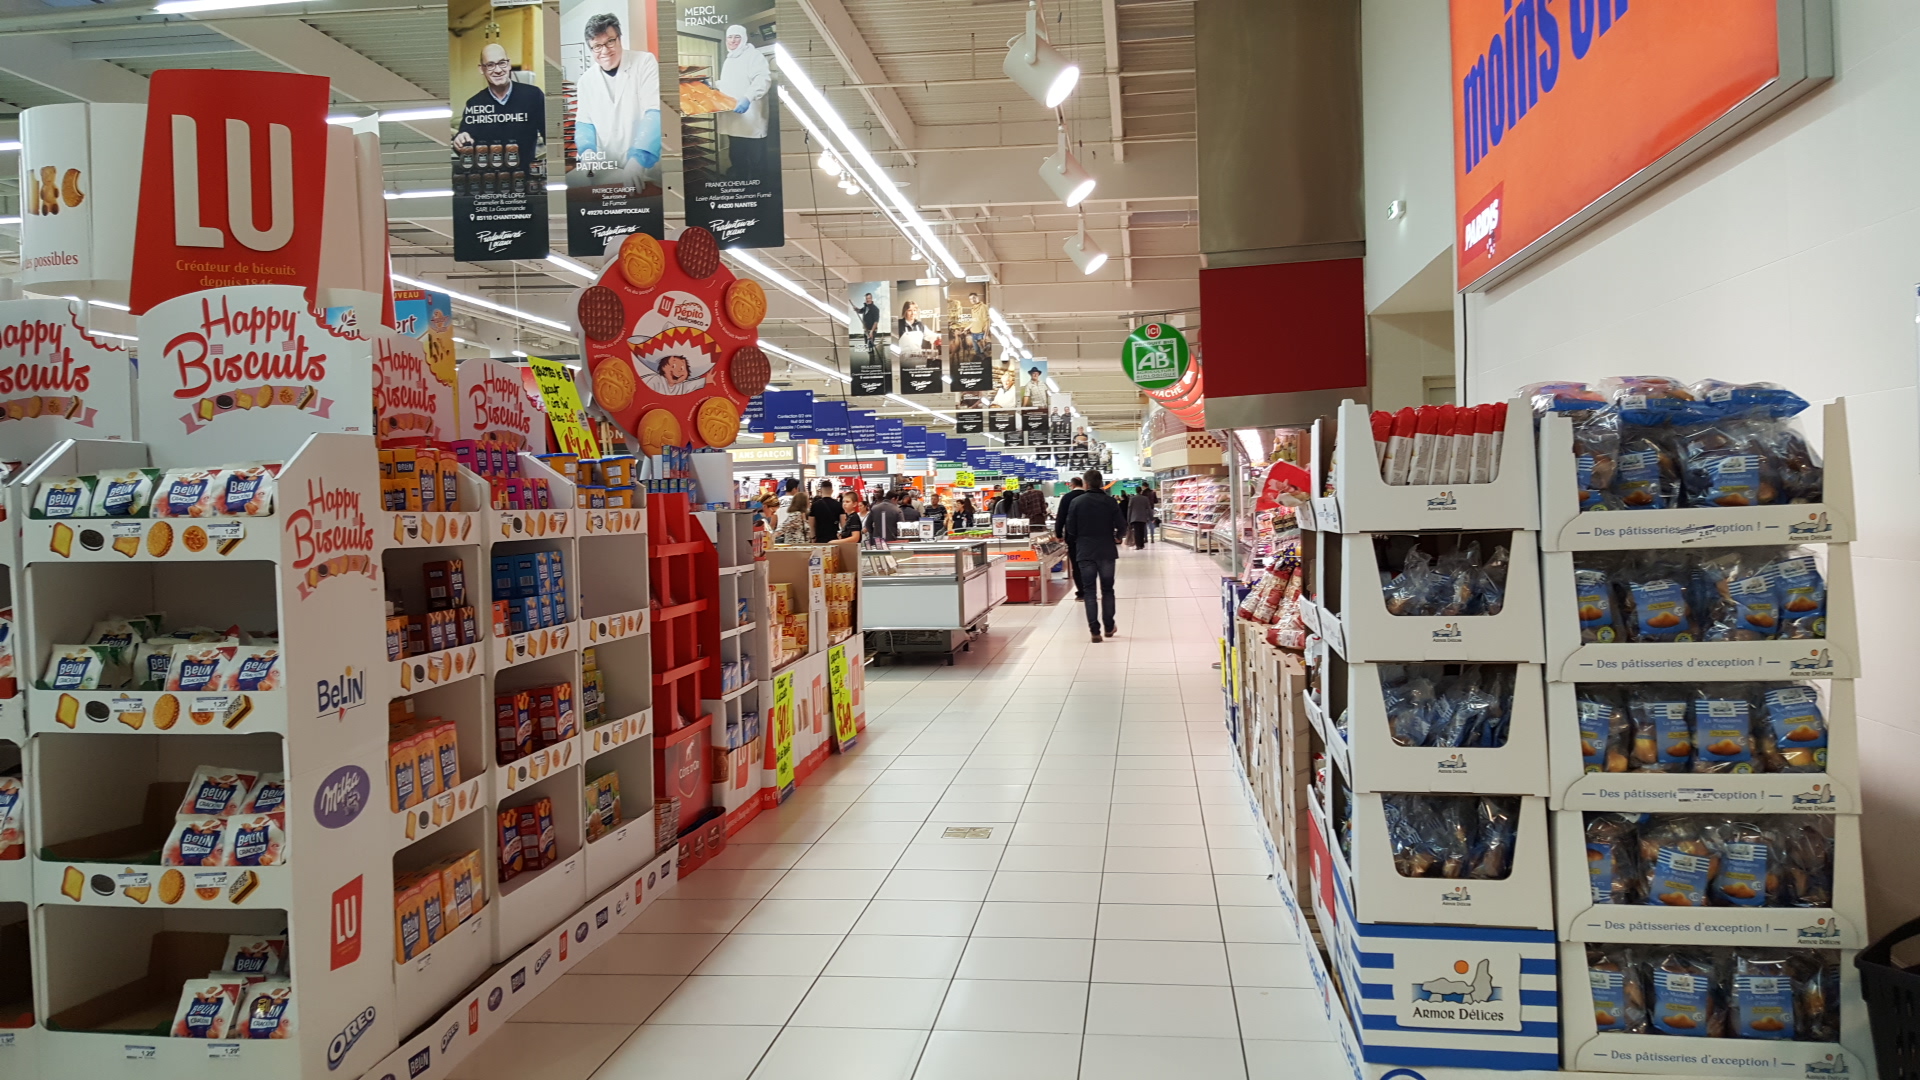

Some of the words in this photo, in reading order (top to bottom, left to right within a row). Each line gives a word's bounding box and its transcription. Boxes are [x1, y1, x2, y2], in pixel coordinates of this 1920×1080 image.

[684, 6, 716, 16] MERCI
[1463, 0, 1560, 176] moins
[465, 104, 496, 115] MERCI
[575, 151, 607, 162] MERCI
[171, 113, 295, 252] LU
[33, 251, 79, 272] possibles
[176, 259, 232, 274] Créateur
[234, 262, 250, 274] de
[252, 262, 297, 276] biscuits
[200, 294, 298, 345] Happy
[673, 305, 705, 319] Pépito
[0, 320, 63, 357] appy
[1147, 326, 1160, 336] ICI
[163, 332, 327, 399] Biscuits
[378, 337, 423, 382] Happy
[1138, 351, 1171, 371] AB
[373, 364, 437, 416] Biscuits
[483, 363, 521, 400] Happy
[469, 385, 532, 434] Biscuits
[742, 450, 756, 459] ANS
[757, 448, 793, 460] GARÇON
[839, 463, 874, 471] CHAUSSURE
[308, 476, 361, 521] Happy
[285, 508, 374, 570] Biscuits
[1593, 527, 1615, 538] Des
[1618, 524, 1681, 539] pâtisseries
[1596, 658, 1618, 669] Des
[1620, 657, 1683, 672] pâtisseries
[1686, 656, 1755, 671] d'exception
[320, 771, 361, 816] Milka
[1599, 789, 1620, 798] Des
[1623, 787, 1678, 801] pâtisserie
[335, 894, 357, 945] LU
[1604, 920, 1626, 930] Des
[1628, 920, 1690, 934] pâtisseries
[1694, 922, 1764, 936] d'exception
[1459, 1007, 1505, 1022] Délices
[328, 1007, 376, 1064] OREO
[1611, 1050, 1632, 1060] Des
[1635, 1051, 1698, 1064] pâtisseries
[1701, 1053, 1770, 1067] d'exception
